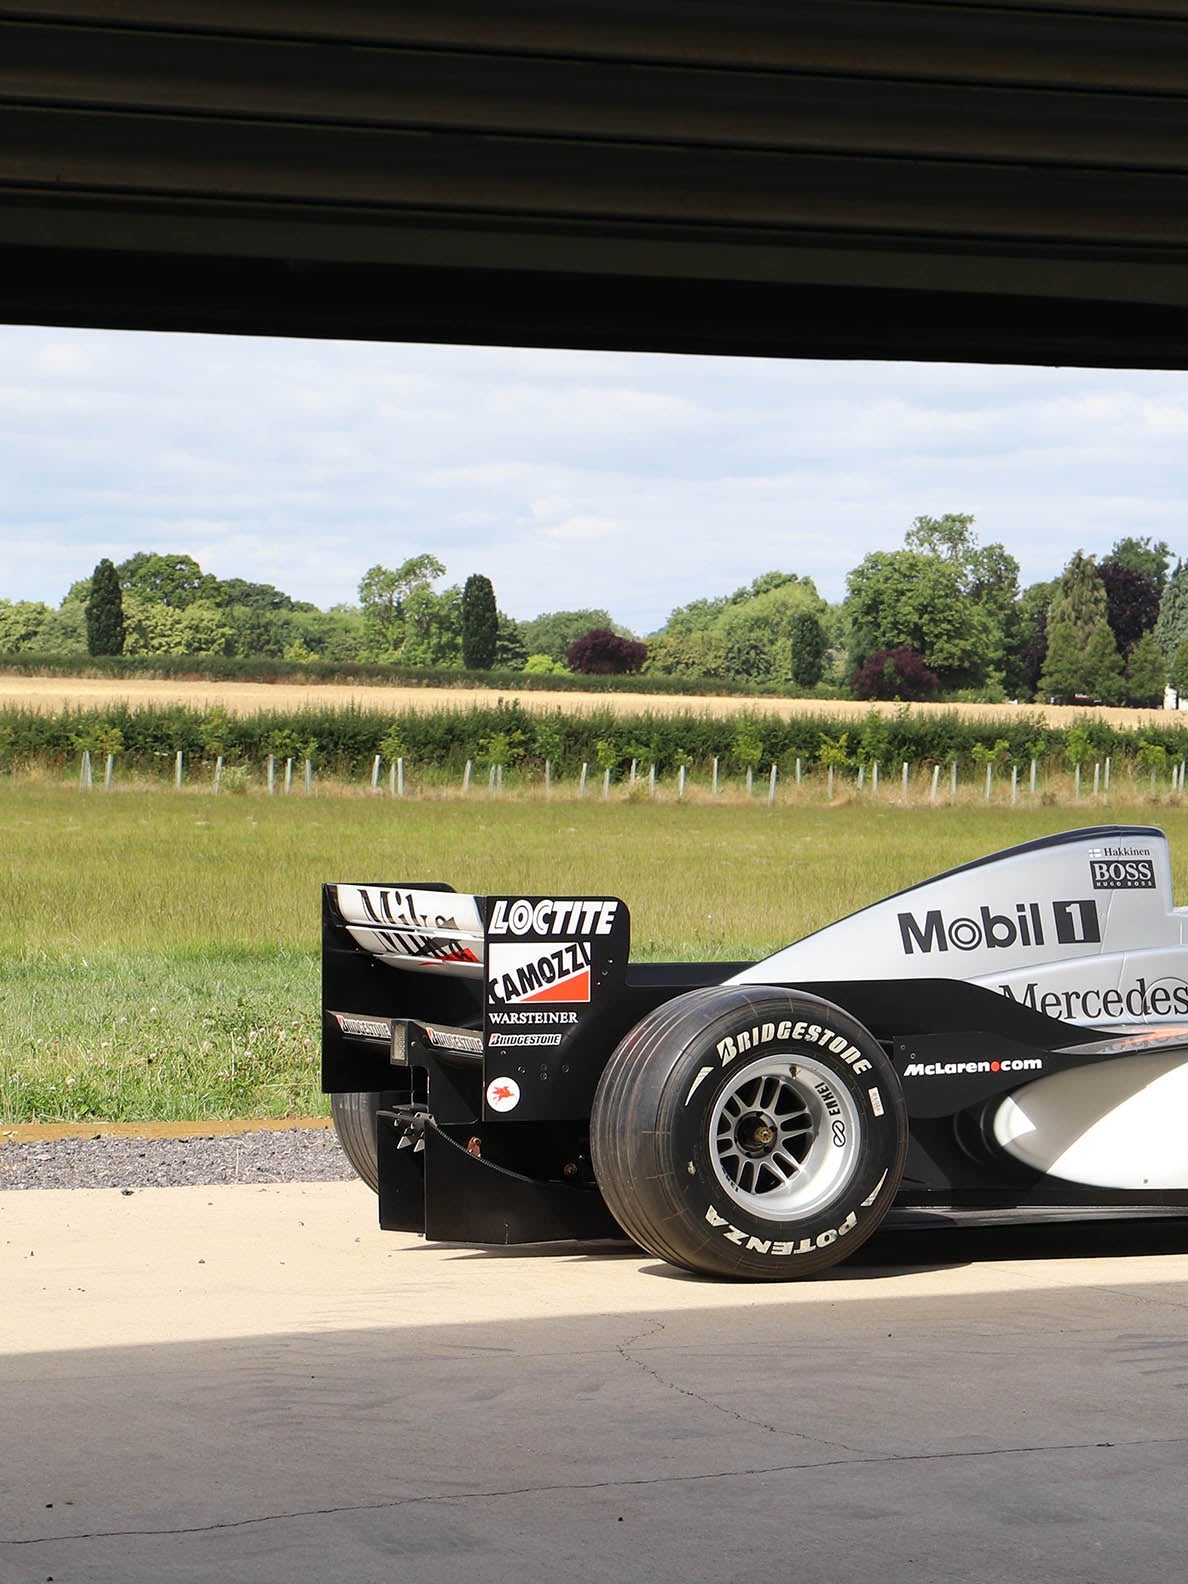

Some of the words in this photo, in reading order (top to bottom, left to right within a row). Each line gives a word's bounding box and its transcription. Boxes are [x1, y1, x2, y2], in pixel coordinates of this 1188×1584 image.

[1103, 847, 1151, 857] Hakkinen
[1093, 862, 1152, 881] BOSS
[487, 899, 619, 936] LOCTITE
[897, 903, 1044, 955] Mobil
[335, 1015, 392, 1039] BRIDGESTONE
[488, 1012, 579, 1025] WARSTEINER
[425, 1027, 484, 1054] BRIDGESTONE
[488, 1033, 563, 1047] BRIDGESTONE
[715, 1020, 873, 1075] BRIDGESTONE
[814, 1081, 842, 1116] ENKEI
[705, 1204, 858, 1256] POTENZA
